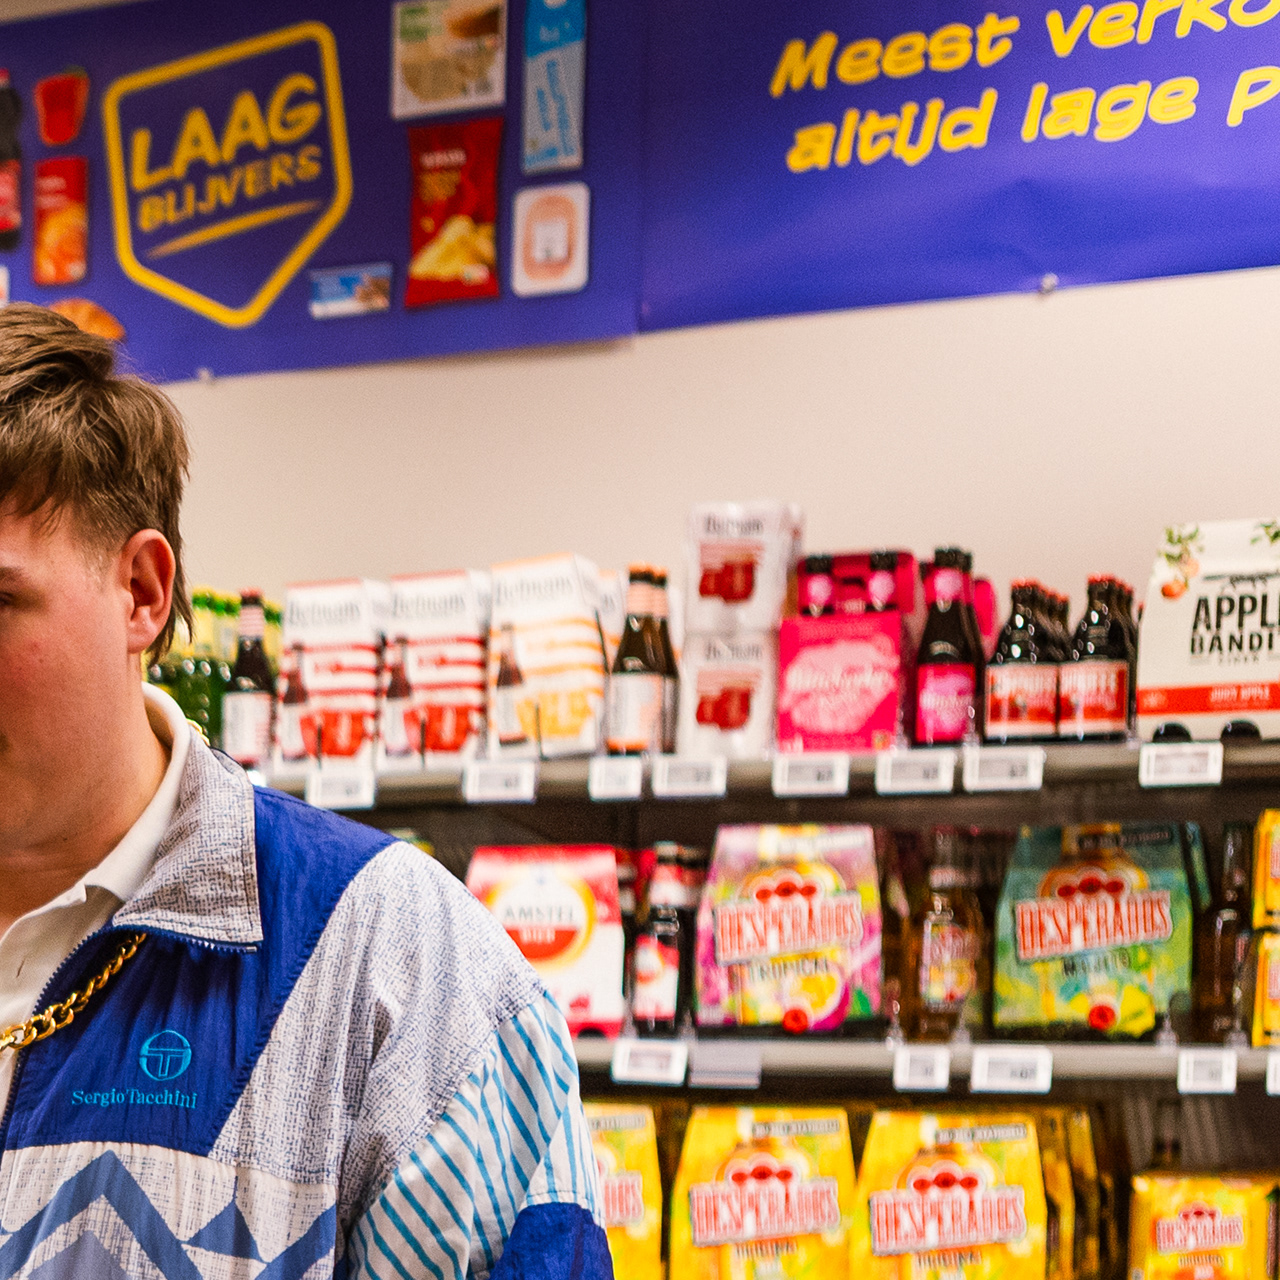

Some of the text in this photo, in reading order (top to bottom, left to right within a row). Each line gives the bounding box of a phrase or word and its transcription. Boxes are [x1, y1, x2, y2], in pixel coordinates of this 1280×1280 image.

[769, 14, 1020, 99] Meest
[131, 74, 322, 191] LAAG
[786, 88, 998, 173] altijd
[1020, 76, 1200, 142] lage
[137, 145, 322, 232] BLIJVERS
[1192, 593, 1280, 630] APPL
[503, 903, 577, 922] AMSTEL
[717, 899, 862, 961] DESPERADOS
[1017, 897, 1172, 959] DESPERADOS
[71, 1087, 198, 1109] Sergio Tacchini
[692, 1182, 839, 1243] DESPERADOS
[872, 1195, 1027, 1254] DESPERADOS
